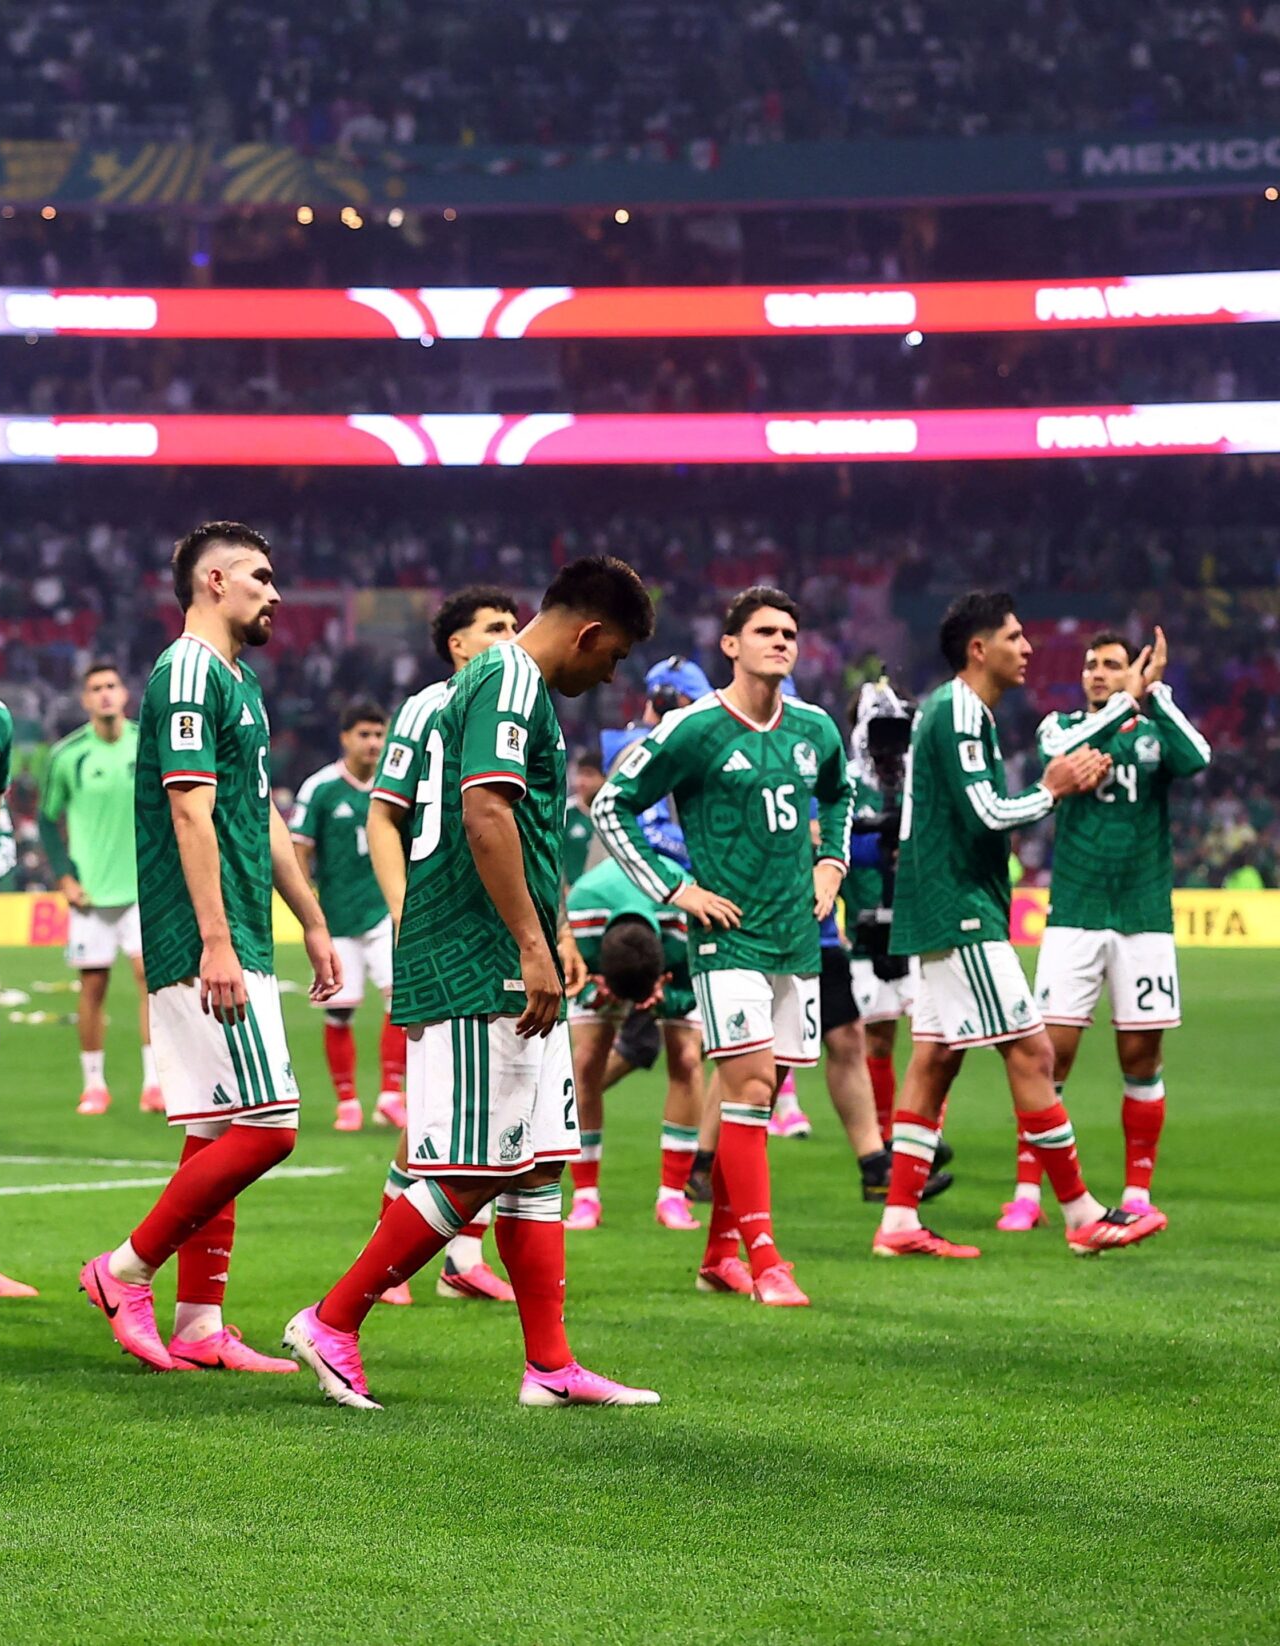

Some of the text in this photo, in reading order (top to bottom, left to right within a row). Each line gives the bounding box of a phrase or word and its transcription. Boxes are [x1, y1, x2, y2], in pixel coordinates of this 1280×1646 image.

[257, 745, 269, 799] 5
[1096, 763, 1137, 803] 24
[761, 784, 798, 833] 15
[1173, 908, 1248, 937] IFA
[1136, 975, 1175, 1010] 24
[803, 997, 817, 1040] 5
